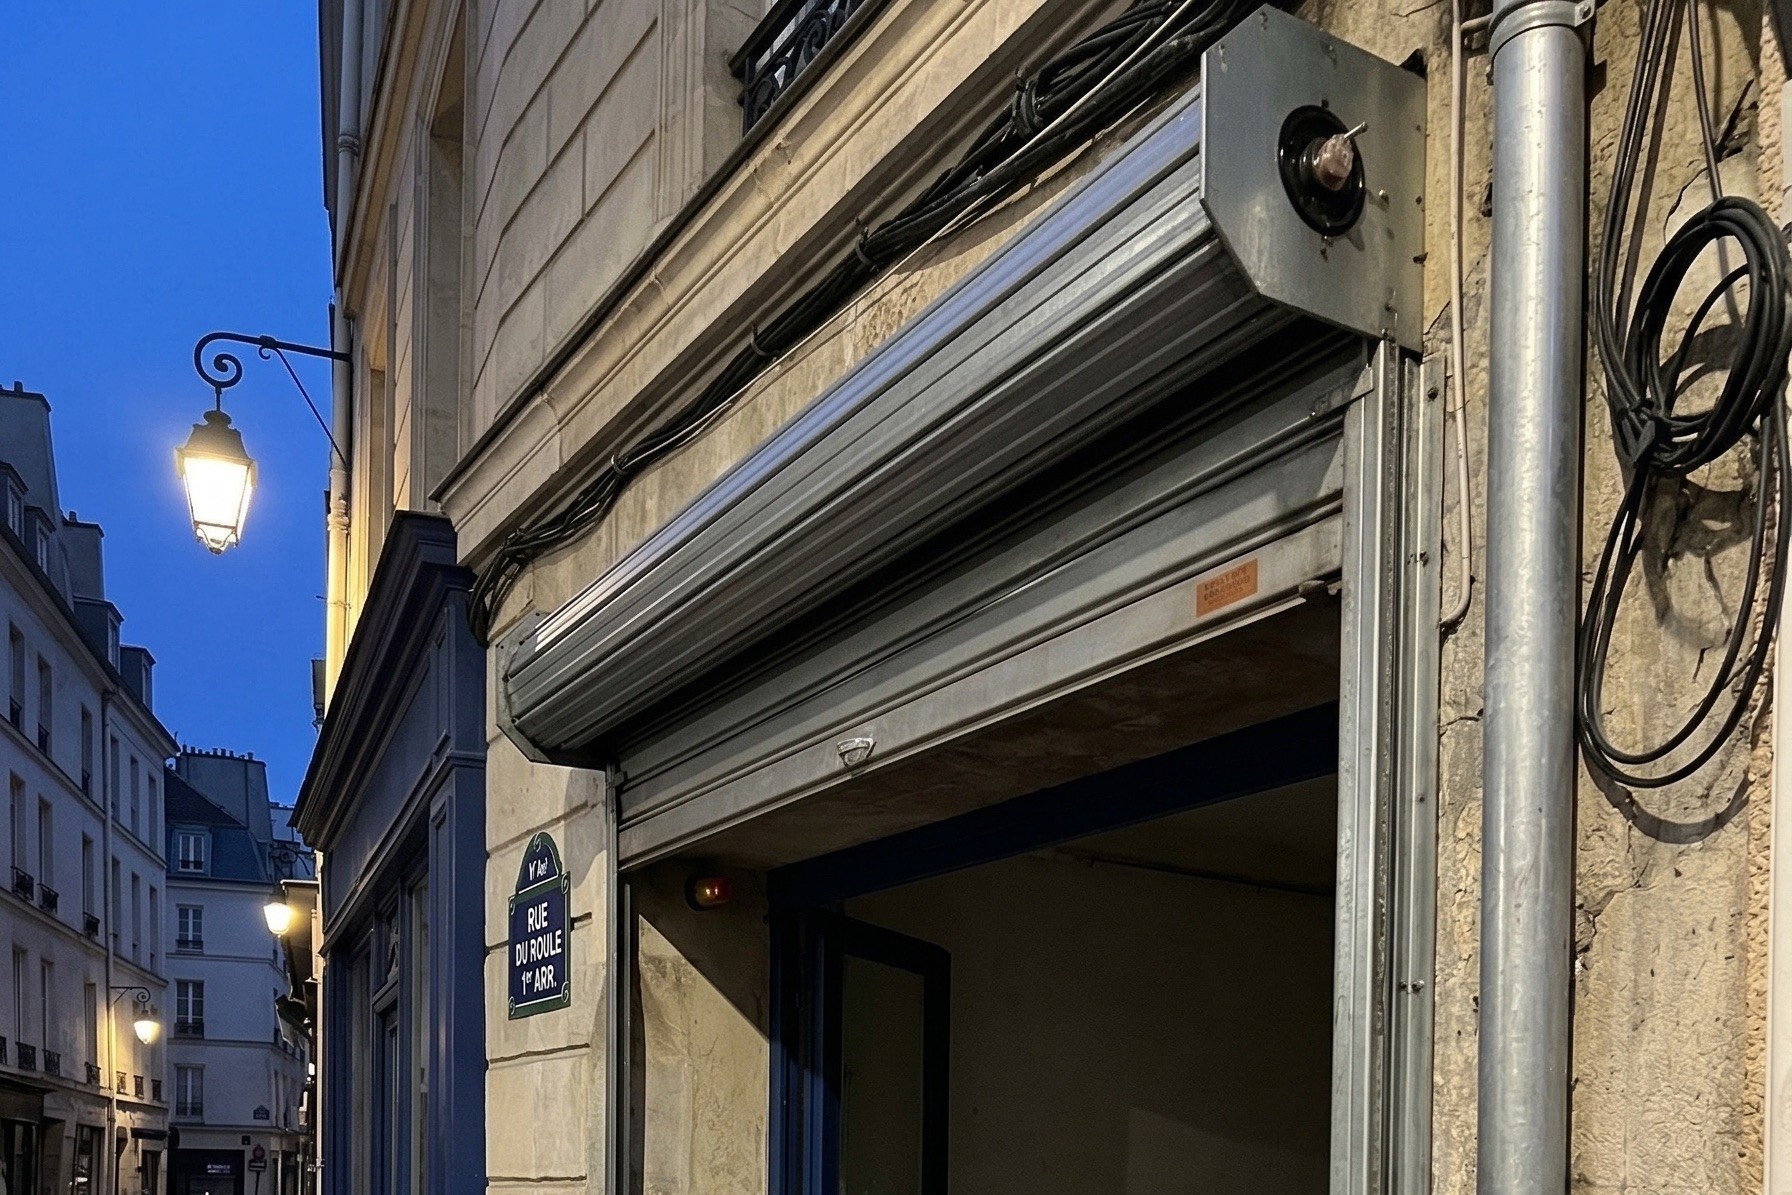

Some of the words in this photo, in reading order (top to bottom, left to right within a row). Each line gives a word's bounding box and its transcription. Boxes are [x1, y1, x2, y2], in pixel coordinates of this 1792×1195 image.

[527, 901, 548, 933] RUE
[515, 941, 529, 967] DU
[530, 929, 562, 963] ROULE
[533, 964, 557, 991] ARR.
